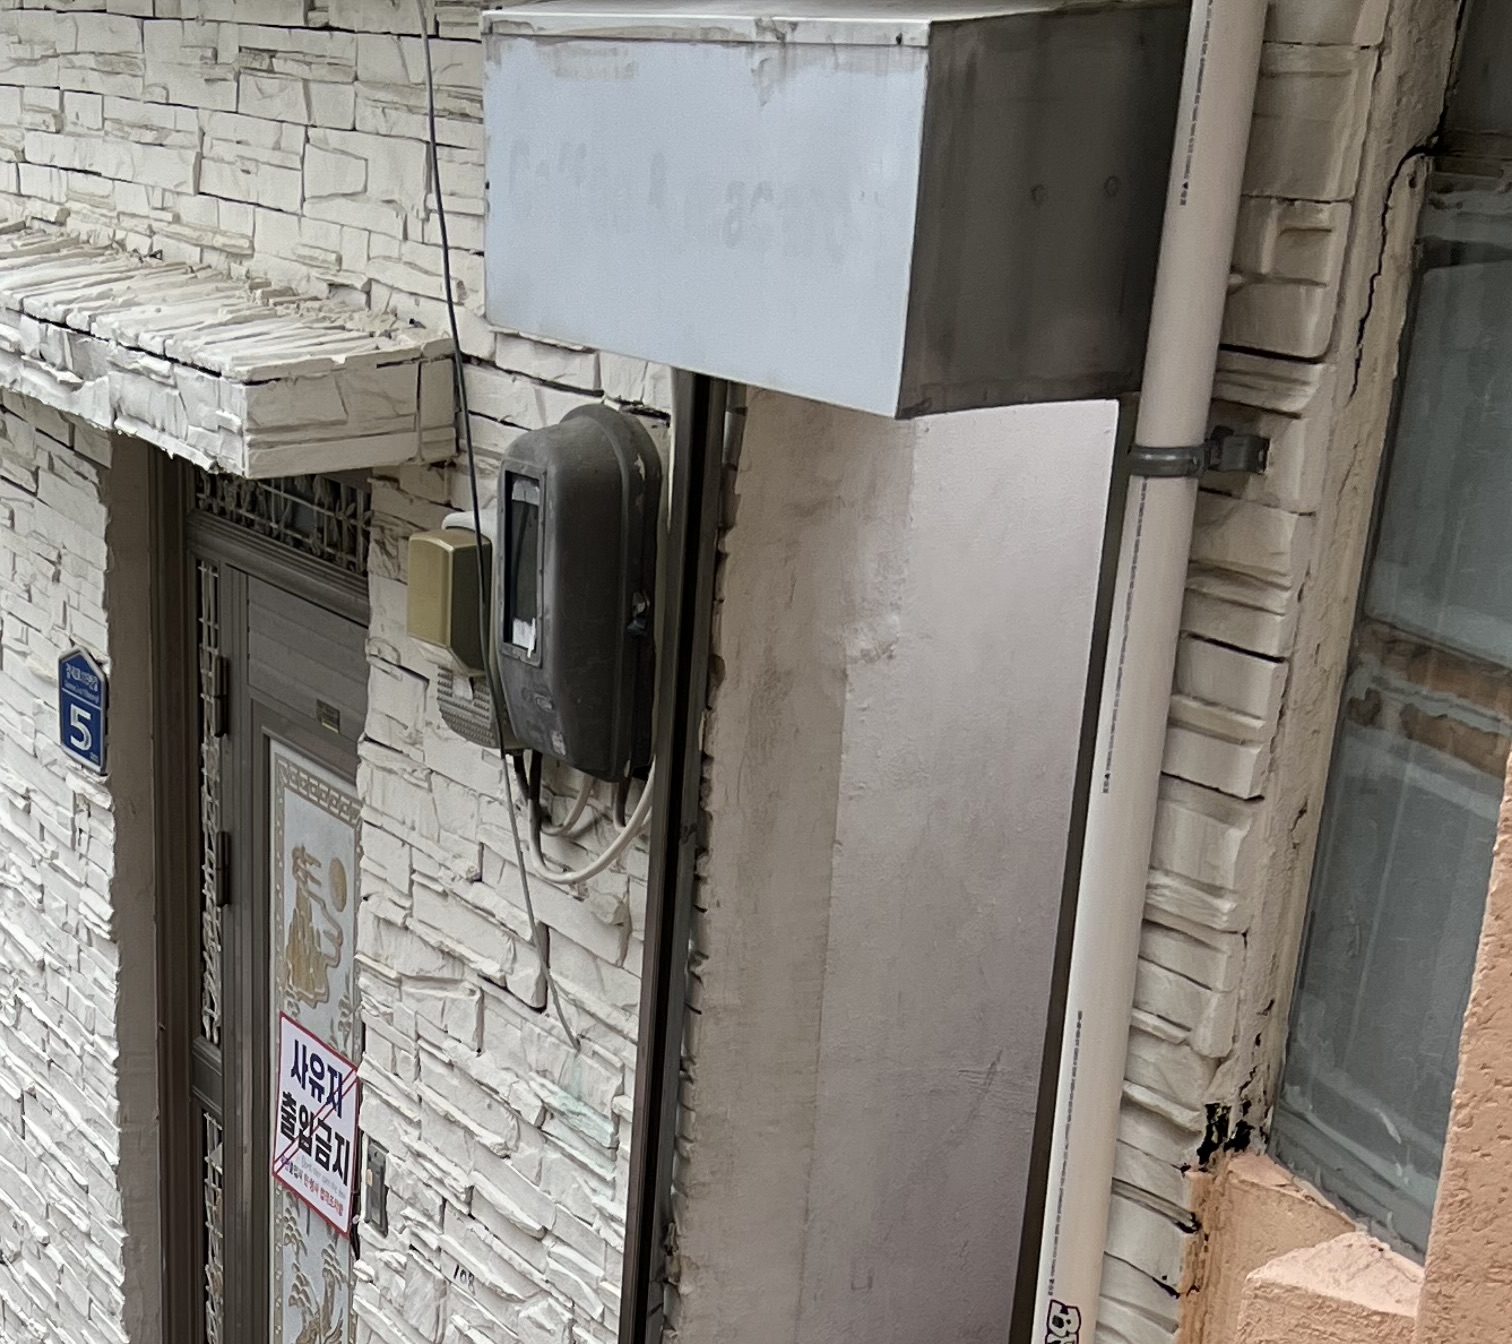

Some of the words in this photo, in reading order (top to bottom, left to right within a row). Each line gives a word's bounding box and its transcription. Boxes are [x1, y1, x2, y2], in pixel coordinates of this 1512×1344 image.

[70, 703, 92, 751] 5
[290, 1039, 344, 1119] 사유지
[280, 1090, 351, 1187] 출입금지
